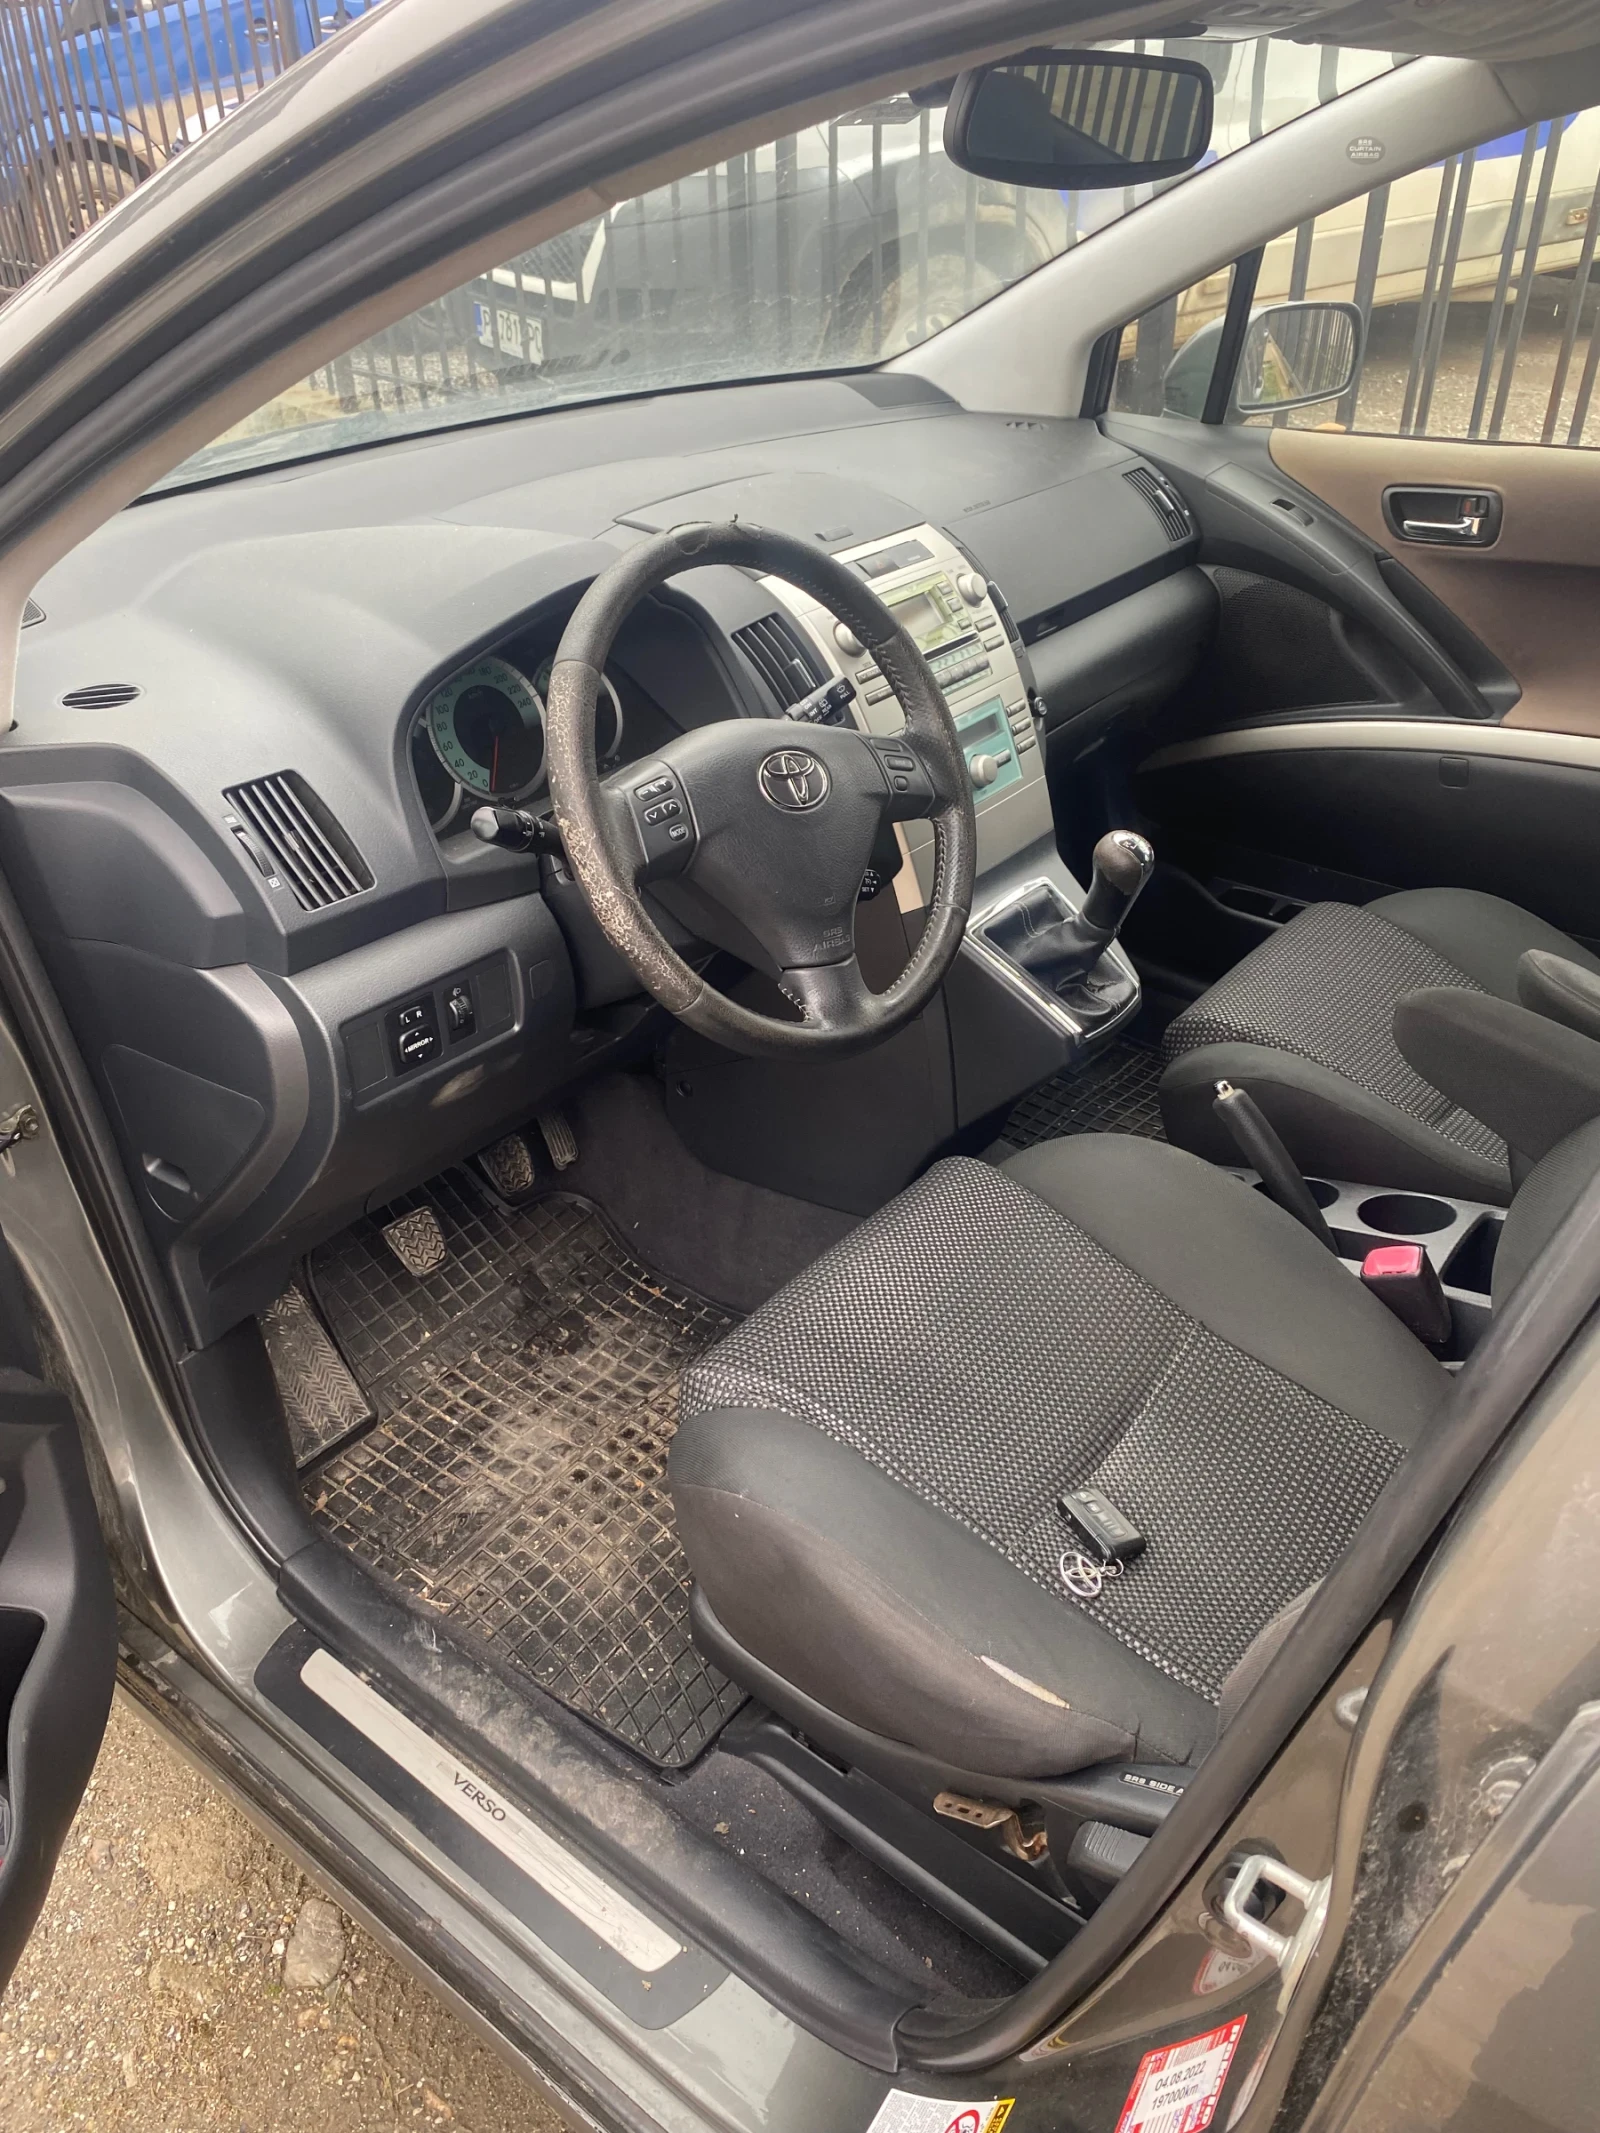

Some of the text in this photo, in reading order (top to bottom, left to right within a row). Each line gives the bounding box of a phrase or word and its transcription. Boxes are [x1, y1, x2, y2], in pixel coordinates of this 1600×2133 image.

[494, 674, 508, 684] 200
[507, 683, 522, 695] 220
[840, 691, 851, 700] PULL
[518, 697, 532, 709] 240
[435, 703, 450, 715] 100
[808, 708, 818, 716] INT
[822, 704, 833, 714] REAR
[436, 721, 448, 732] 80
[442, 741, 454, 751] 60
[454, 758, 465, 768] 40
[467, 769, 479, 780] 20
[482, 778, 489, 788] 0
[823, 926, 843, 938] SRS
[405, 1010, 423, 1024] L R
[408, 1037, 430, 1052] MIRROR
[1124, 1773, 1147, 1785] SRS
[1149, 1780, 1176, 1793] SIDE
[454, 1770, 506, 1821] VERSO
[1154, 2060, 1207, 2092] 04.08.2022
